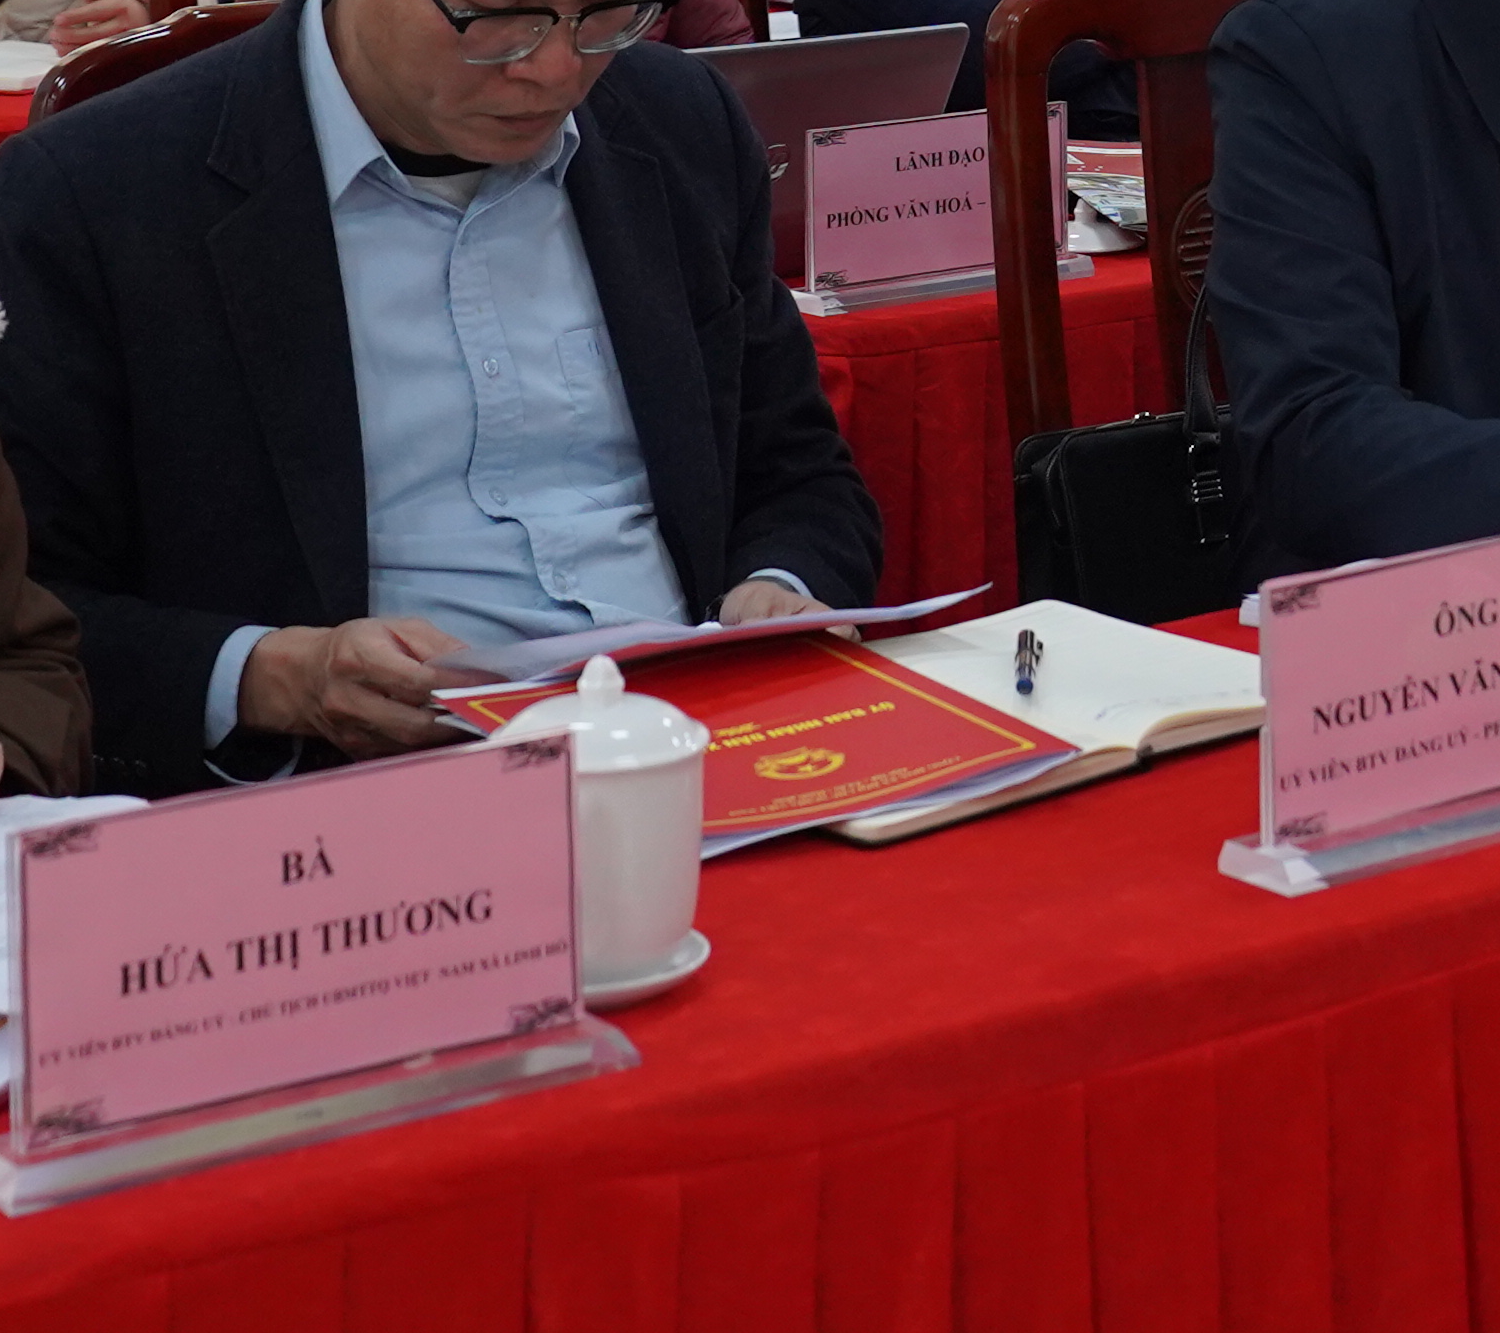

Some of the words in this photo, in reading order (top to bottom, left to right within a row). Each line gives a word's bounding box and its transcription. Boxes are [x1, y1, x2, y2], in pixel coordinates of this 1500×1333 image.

[895, 150, 944, 172] LÃNH
[948, 146, 986, 168] ĐẠO
[826, 205, 890, 230] PHÒNG
[894, 198, 931, 220] VĂN
[935, 191, 973, 215] HOÁ
[1433, 596, 1500, 639] ÔNG
[1311, 674, 1440, 735] NGUYỄN
[280, 836, 335, 888] BÀ
[119, 942, 215, 997] HỨA
[224, 928, 299, 974] THỊ
[312, 888, 494, 956] THƯƠNG
